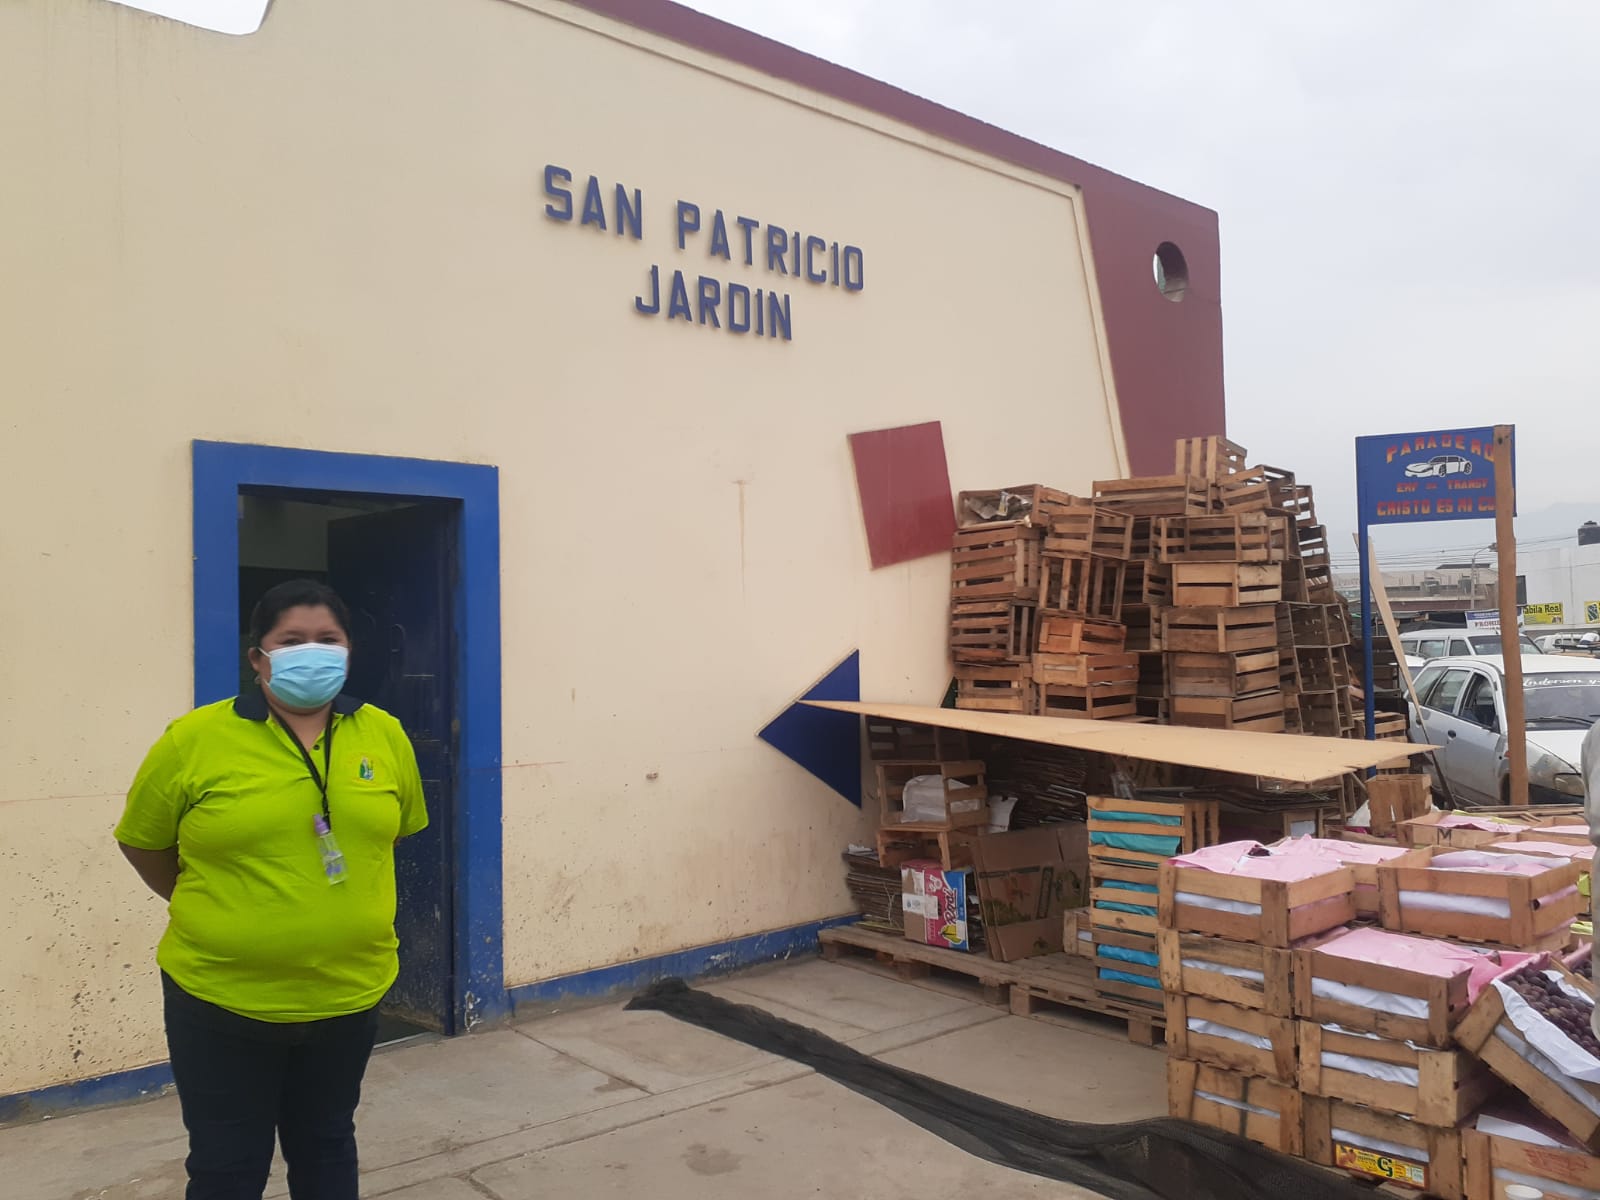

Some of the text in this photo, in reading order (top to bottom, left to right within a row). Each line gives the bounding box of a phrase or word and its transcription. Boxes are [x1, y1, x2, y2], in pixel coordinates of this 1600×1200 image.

[543, 164, 865, 292] SAN PATRICIO
[634, 264, 793, 342] JARDIN
[1387, 434, 1494, 463] PARADERO
[1376, 500, 1431, 516] CRISTO
[1436, 498, 1454, 514] ES
[1457, 497, 1473, 513] MI
